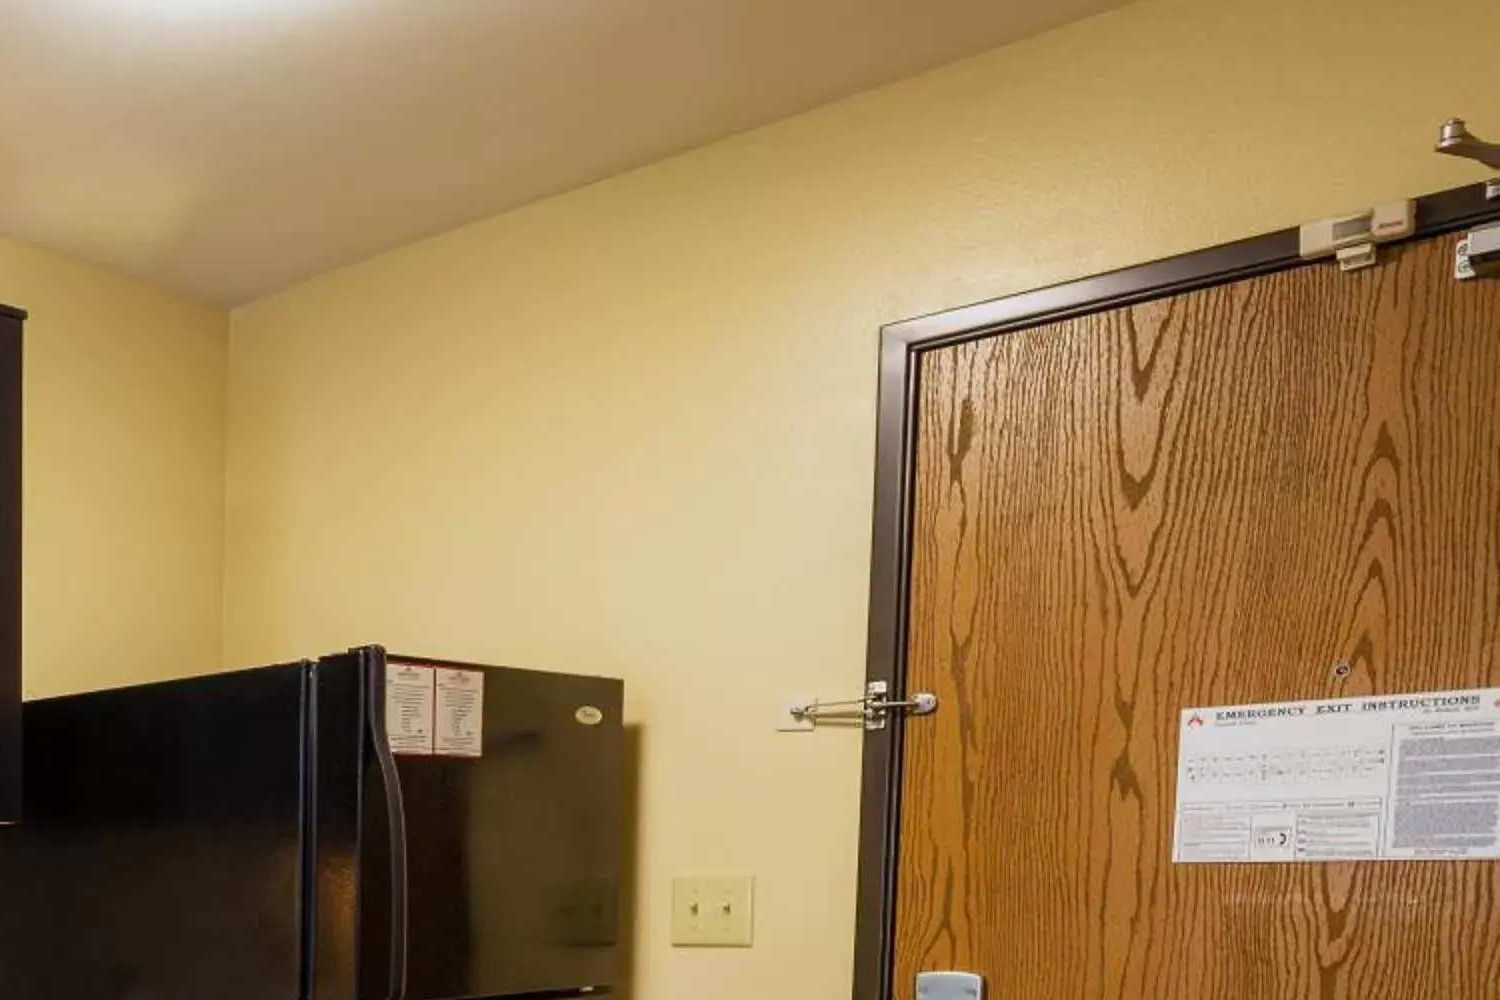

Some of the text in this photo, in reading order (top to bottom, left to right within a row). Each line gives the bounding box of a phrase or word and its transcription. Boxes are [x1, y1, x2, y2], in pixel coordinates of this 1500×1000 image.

[1215, 707, 1305, 721] EMERGENCY
[1316, 703, 1353, 714] EXIT
[1361, 695, 1480, 711] INSTRUCTIONS
